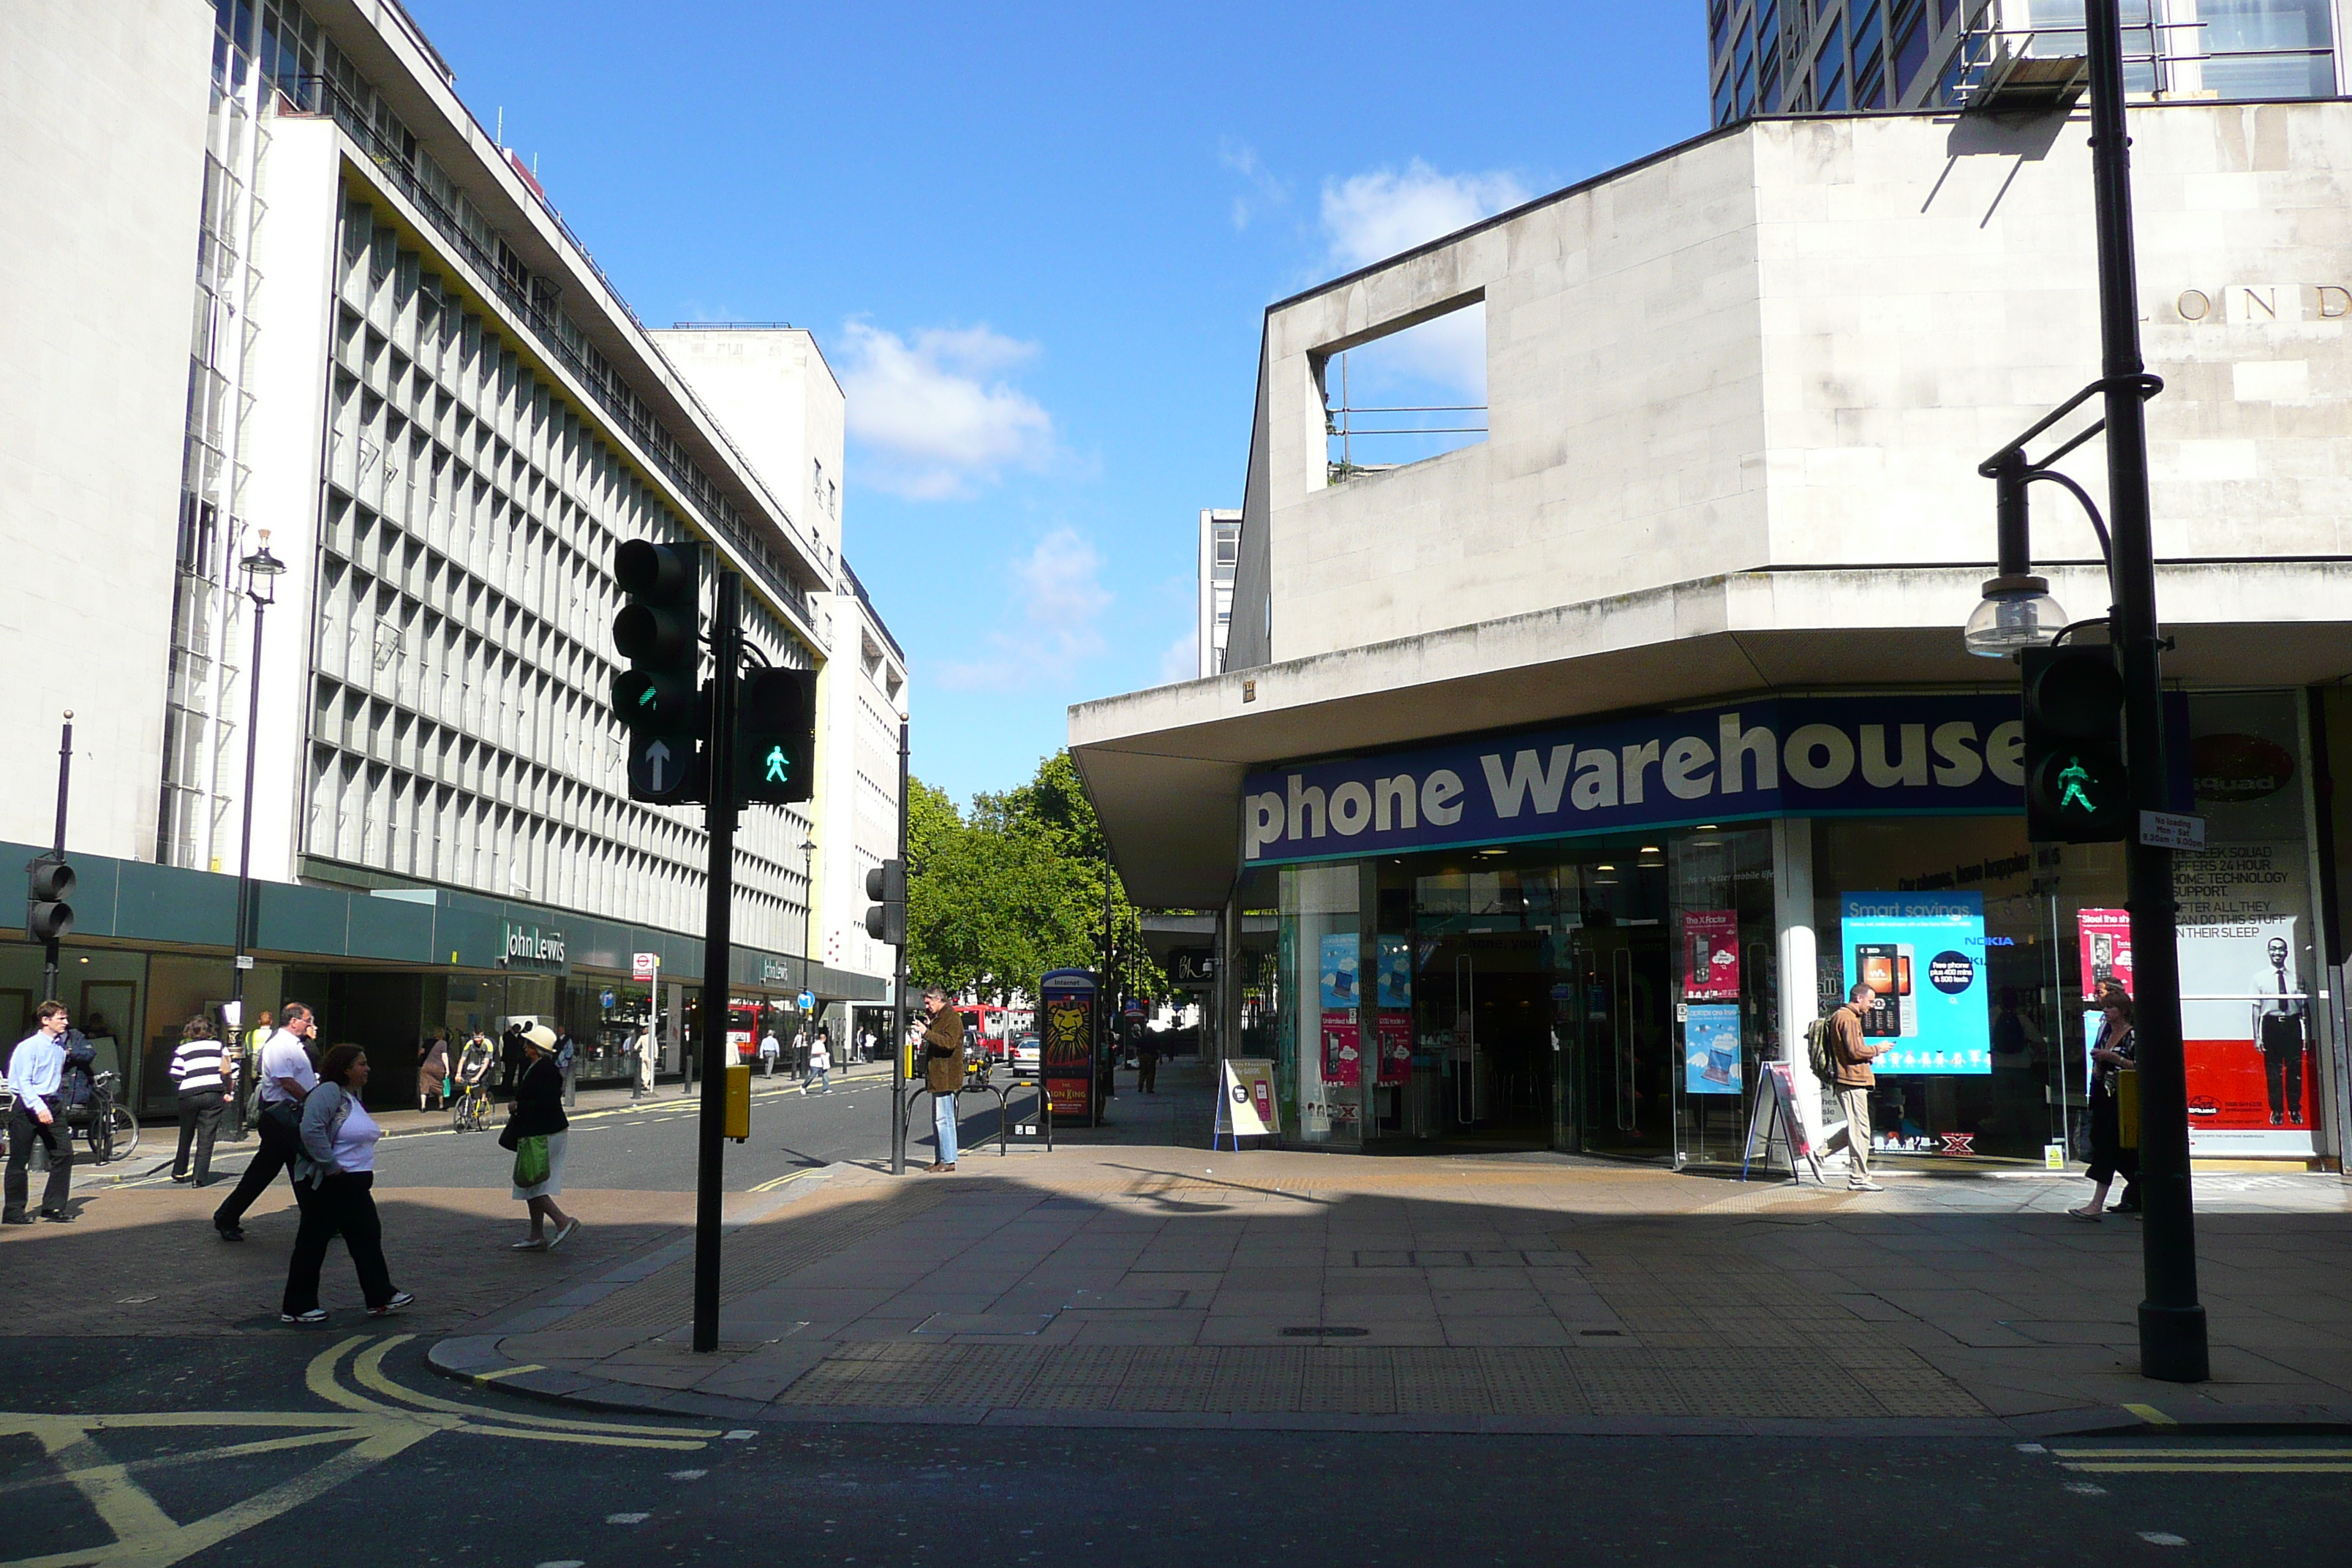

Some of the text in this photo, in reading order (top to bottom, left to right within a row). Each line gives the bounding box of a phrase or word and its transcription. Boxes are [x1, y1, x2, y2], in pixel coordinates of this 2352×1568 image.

[2138, 286, 2352, 322] OND
[1245, 712, 2026, 859] phone Warehouse
[2155, 816, 2192, 829] No loading
[2157, 826, 2171, 834] Mon
[2178, 828, 2190, 837] Sat
[2176, 849, 2192, 859] HE
[2231, 846, 2273, 858] SQUAD
[2172, 859, 2271, 872] OFFERS 24 HOUR
[1708, 872, 1733, 882] better
[1734, 870, 1760, 882] mobile
[2208, 872, 2288, 883] TECHNOLOGY
[1850, 901, 1973, 921] Smart savings.
[2179, 901, 2271, 913] FTER ALL THEY
[1700, 916, 1705, 924] X
[1705, 916, 1727, 924] Factor
[2175, 914, 2287, 924] CAN DO THIS STUFF
[2176, 928, 2185, 938] N
[2186, 927, 2220, 938] THEIR
[504, 921, 565, 964] John Lewis
[1964, 937, 2016, 946] NOKIA
[762, 958, 788, 983] John Lewis
[1932, 961, 1970, 970] Free phone
[1929, 968, 1944, 977] plus
[1323, 1017, 1349, 1025] Unlimited
[1050, 1088, 1087, 1100] ION KING
